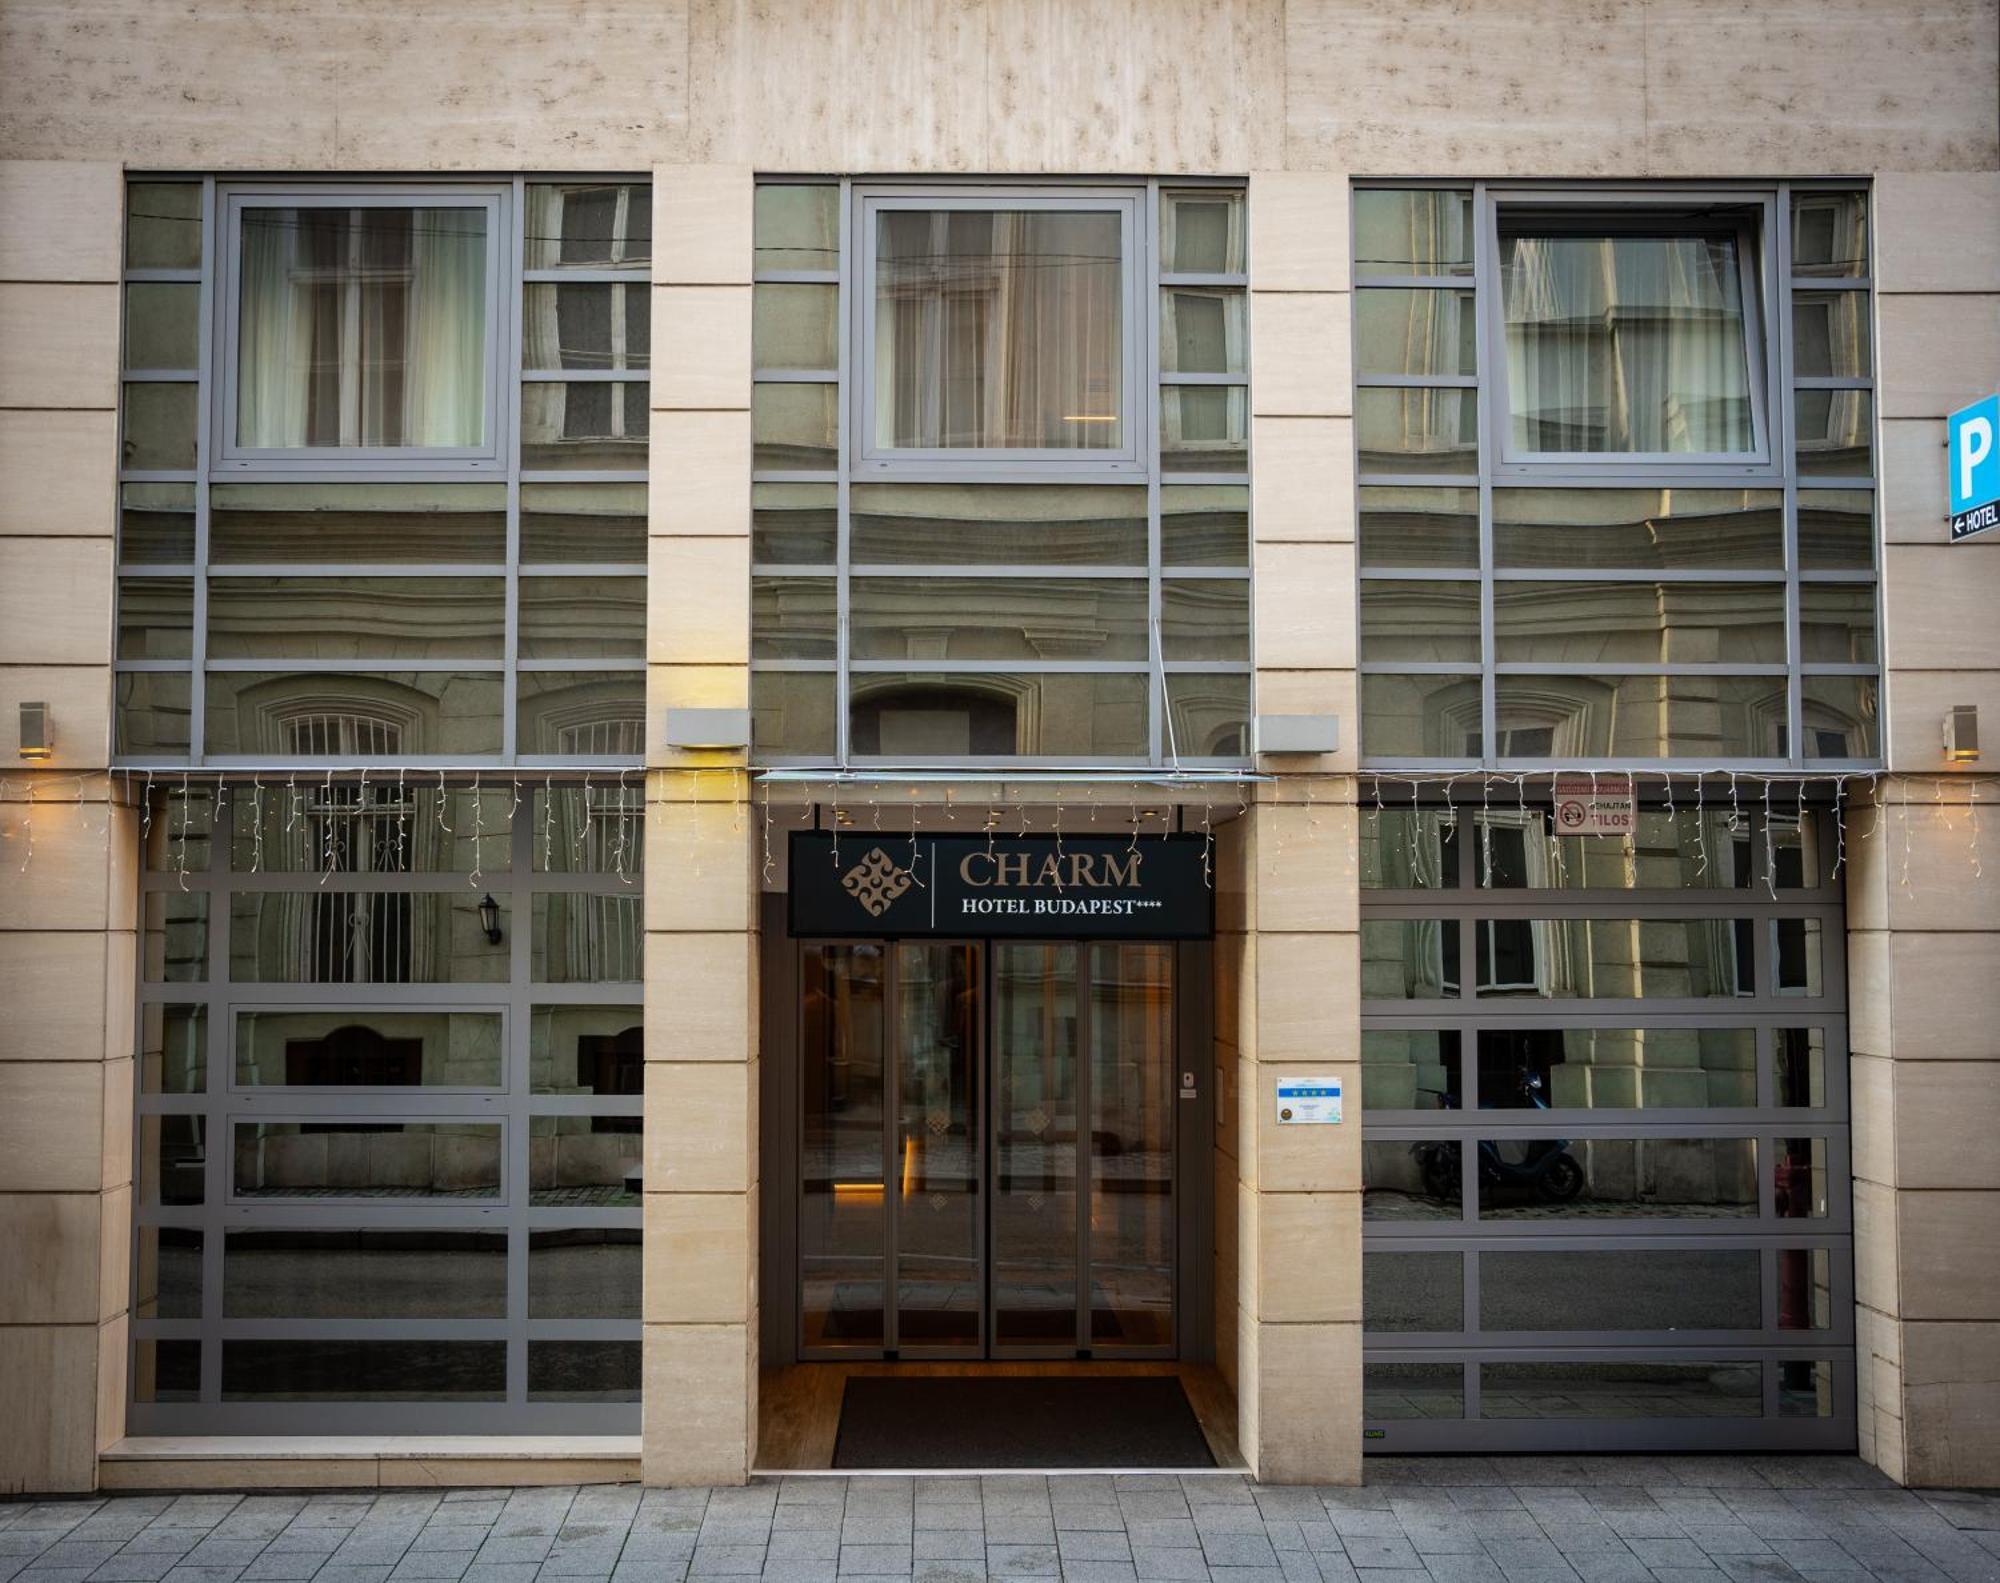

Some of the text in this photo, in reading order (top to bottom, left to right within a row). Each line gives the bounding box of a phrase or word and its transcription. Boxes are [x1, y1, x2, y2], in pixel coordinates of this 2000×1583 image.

[1960, 416, 1993, 500] P
[1966, 504, 1999, 532] HOTEL
[1590, 814, 1629, 826] TILOS
[959, 852, 1142, 887] CHARM
[961, 898, 1029, 915] HOTEL
